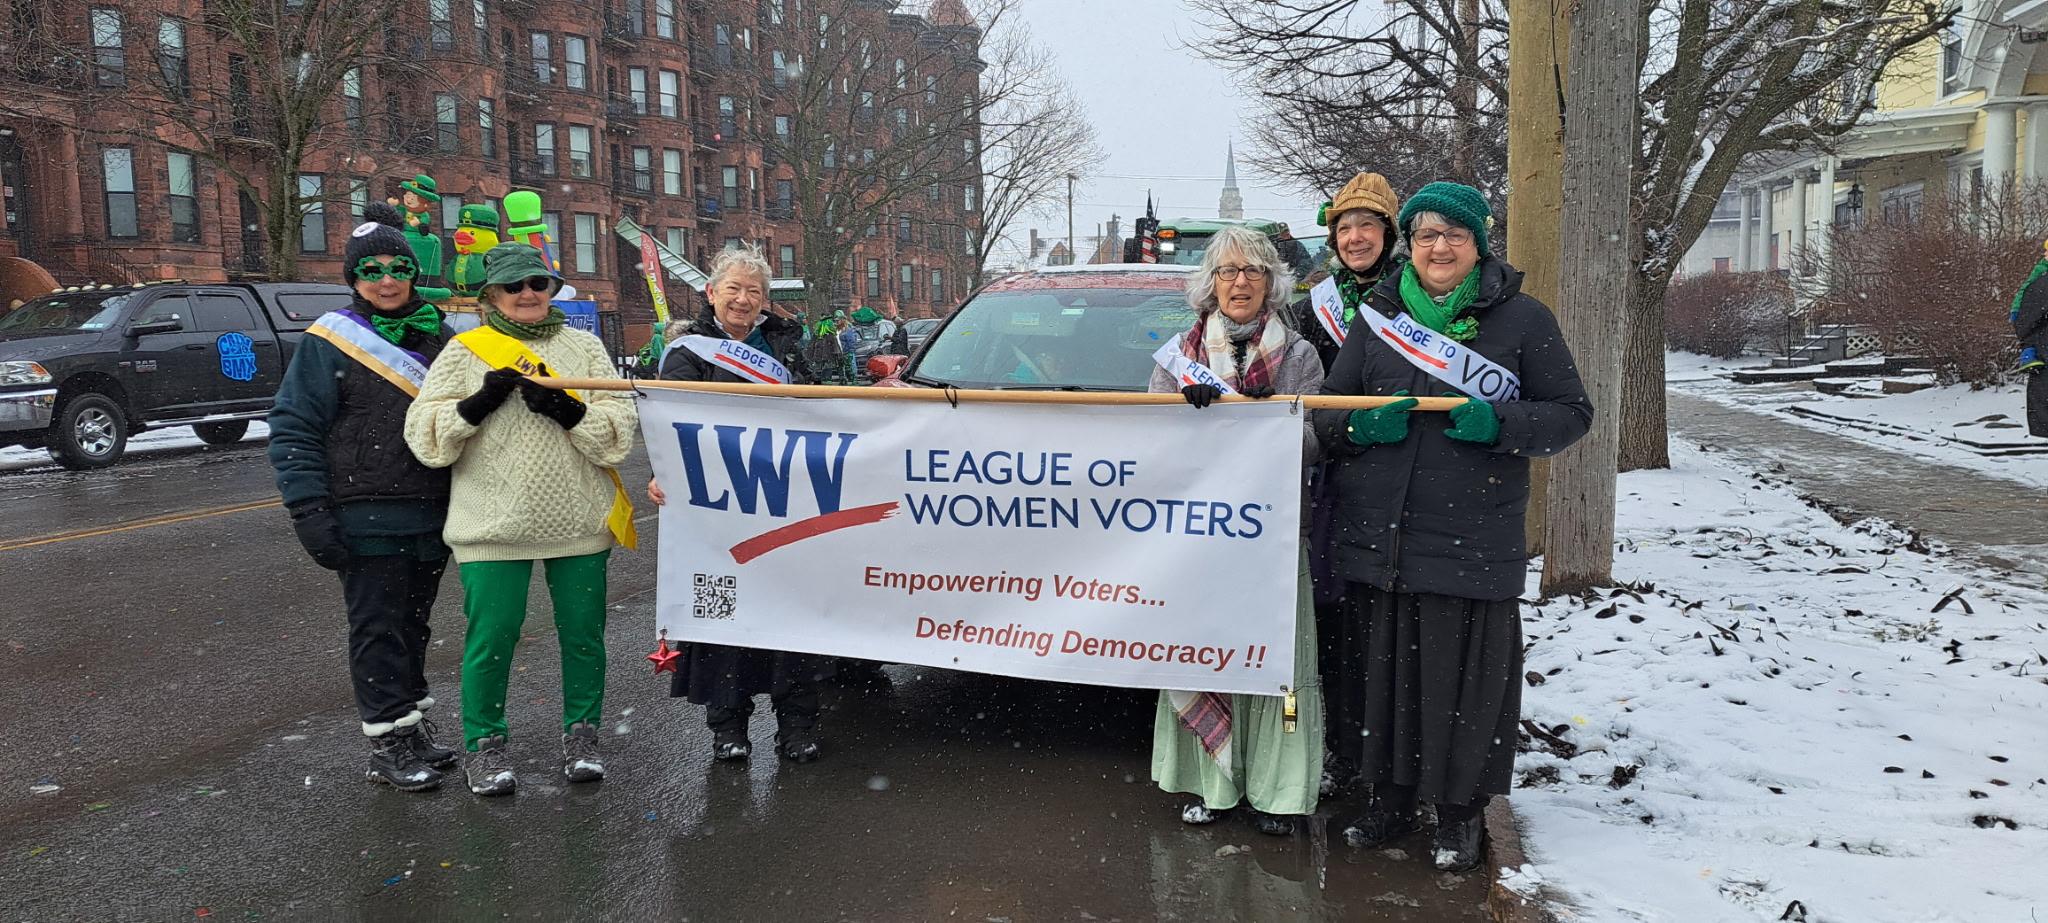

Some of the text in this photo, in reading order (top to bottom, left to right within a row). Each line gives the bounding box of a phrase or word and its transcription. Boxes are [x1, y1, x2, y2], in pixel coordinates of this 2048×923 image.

[1391, 315, 1432, 347] LEDGE
[1436, 340, 1457, 358] TO
[221, 357, 257, 381] BMX
[515, 355, 538, 377] LWV
[719, 340, 783, 377] PLEDGE TO
[672, 422, 859, 517] LWV
[905, 449, 1137, 487] LEAGUE OF
[905, 493, 1079, 529] WOMEN
[864, 566, 1166, 607] Empowering Voters...
[915, 616, 1267, 672] Defending Democracy !!
